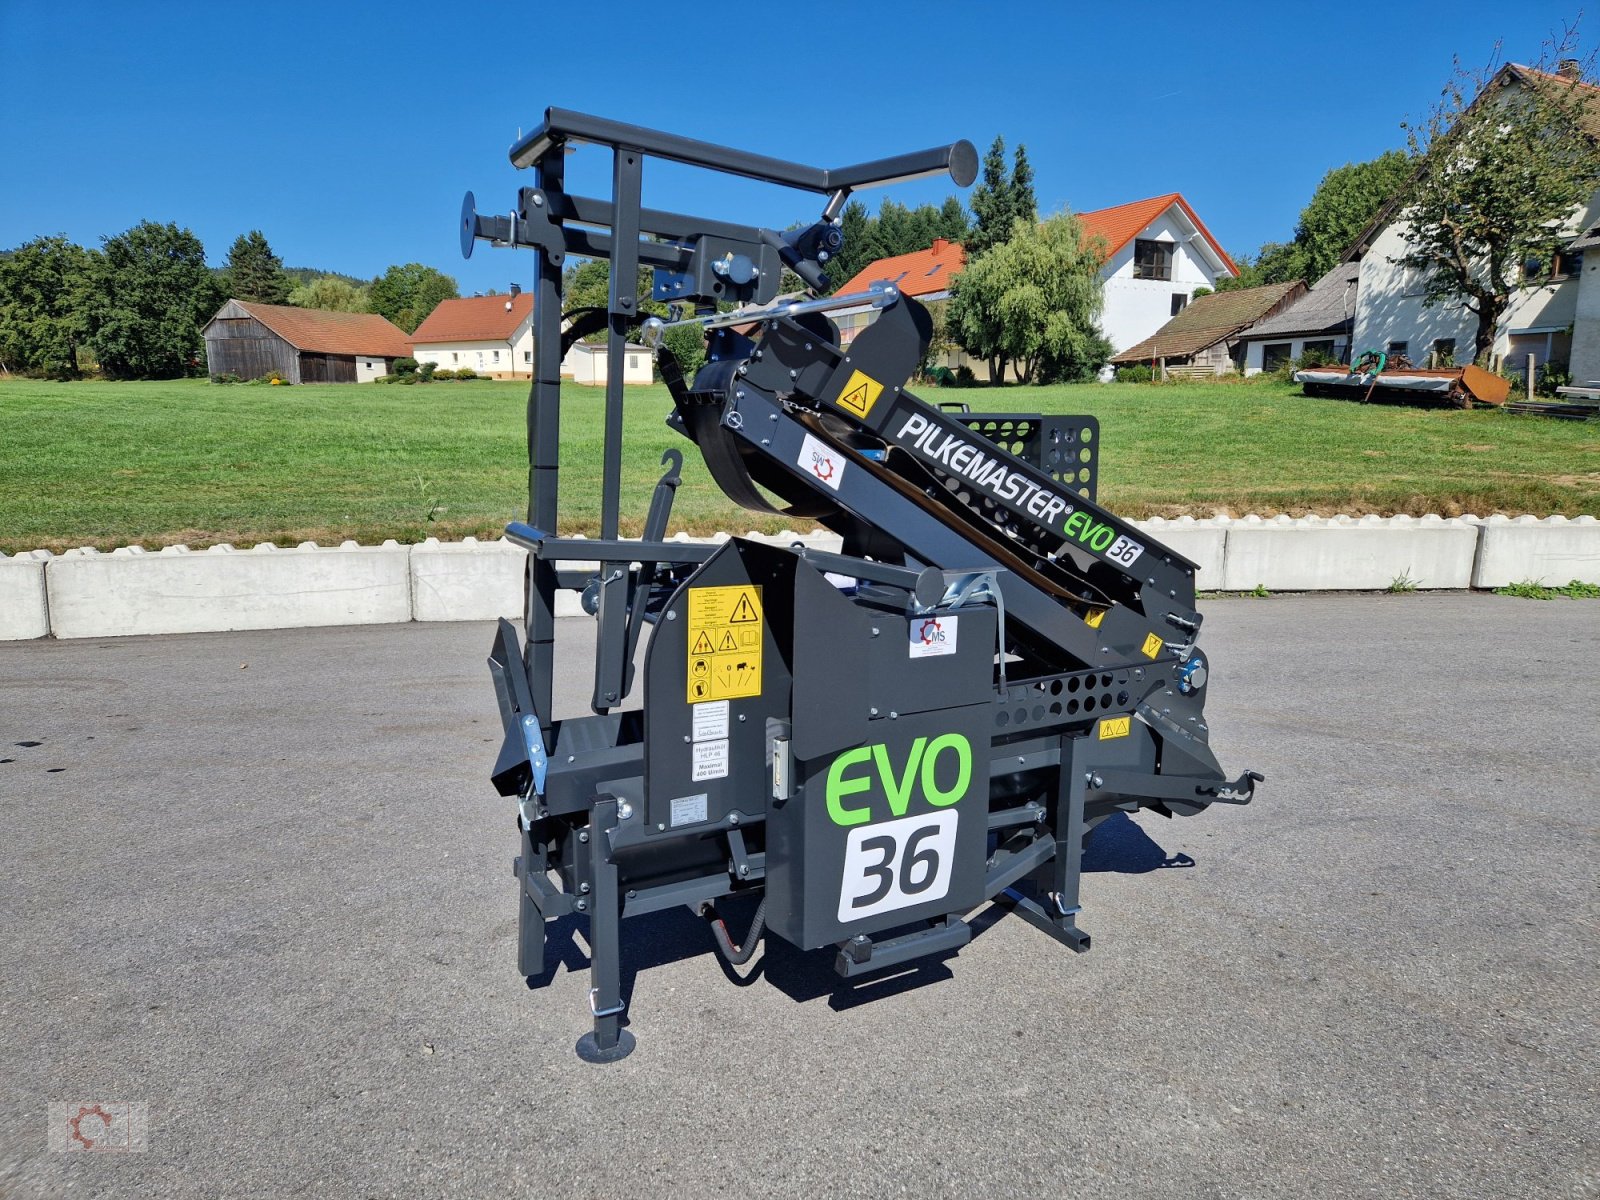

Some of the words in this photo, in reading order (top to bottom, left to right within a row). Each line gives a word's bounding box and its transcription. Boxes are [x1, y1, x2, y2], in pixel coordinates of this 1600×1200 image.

[1063, 511, 1115, 551] EVO
[1110, 540, 1137, 562] 36
[698, 761, 723, 770] Maximal
[826, 733, 972, 826] EVO
[851, 824, 941, 909] 36
